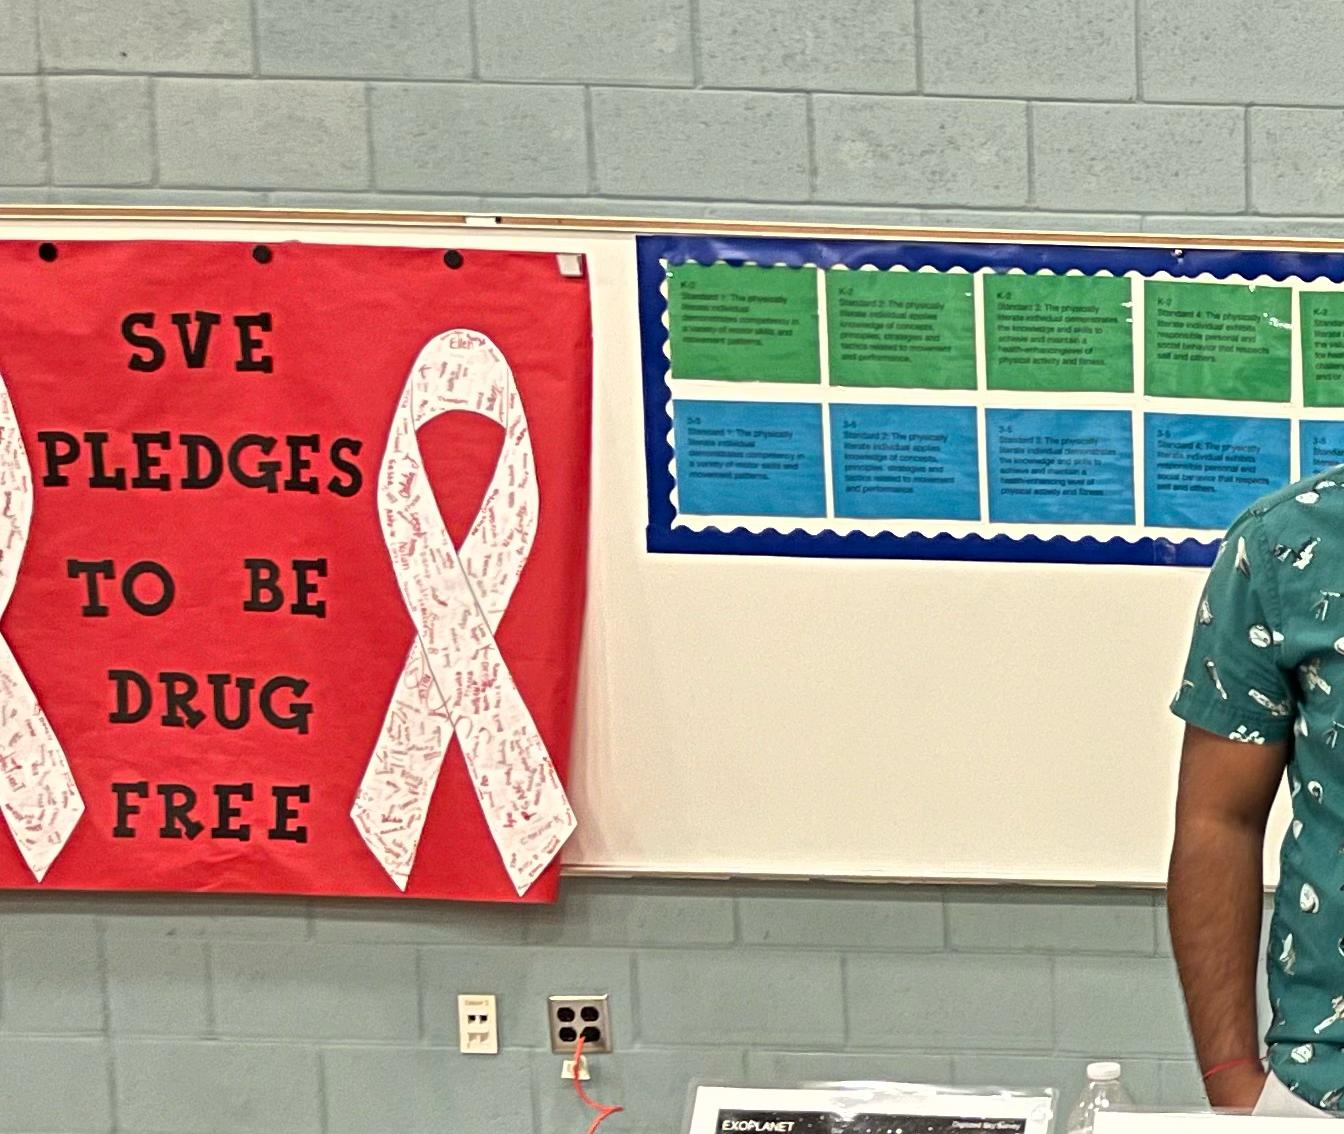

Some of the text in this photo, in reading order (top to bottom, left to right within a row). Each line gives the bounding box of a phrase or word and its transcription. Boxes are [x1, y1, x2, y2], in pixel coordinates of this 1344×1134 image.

[122, 311, 272, 372] SVE
[38, 431, 361, 496] PLEDGES
[68, 559, 326, 617] TO BE
[109, 670, 312, 733] DRUG
[113, 782, 309, 842] FREE
[722, 1120, 795, 1132] EXOPLANET
